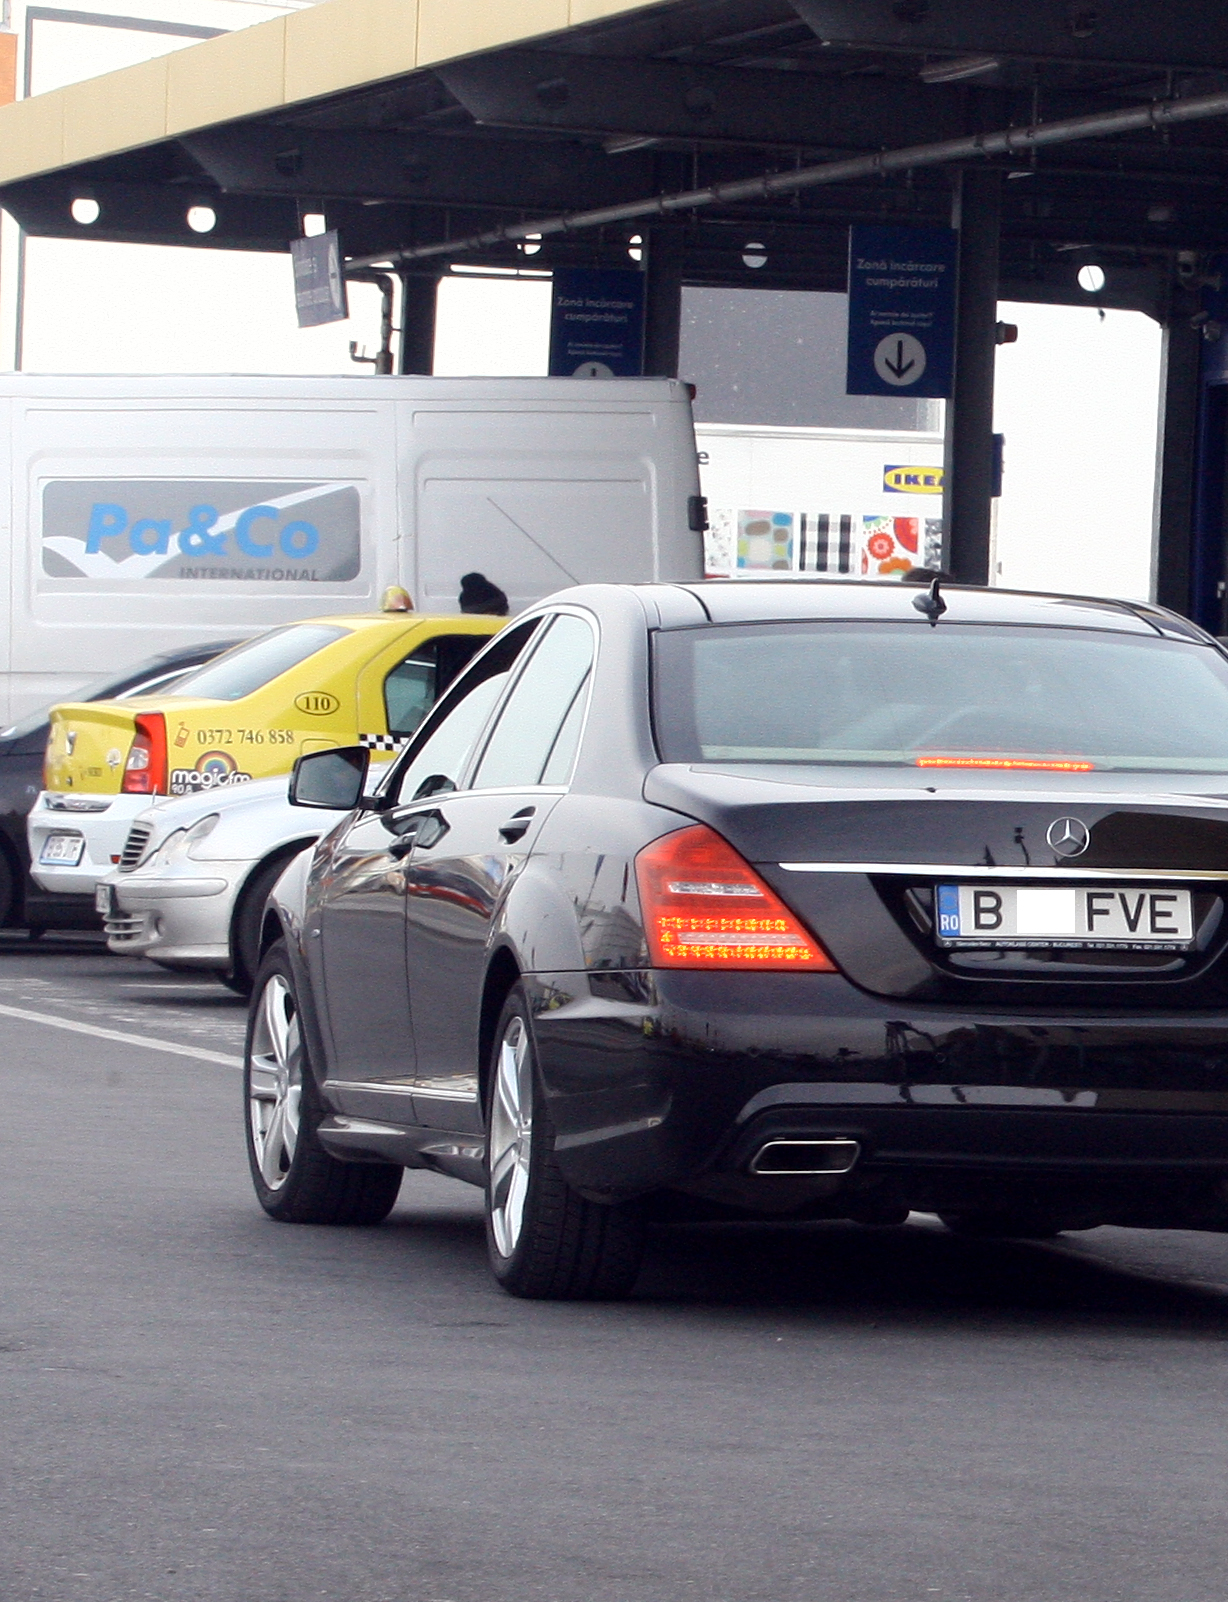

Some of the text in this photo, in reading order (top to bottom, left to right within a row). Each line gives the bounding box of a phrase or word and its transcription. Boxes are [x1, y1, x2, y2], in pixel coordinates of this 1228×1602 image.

[84, 503, 320, 559] Pa&Co
[179, 567, 319, 581] INTERNATIONAL
[303, 696, 330, 711] 110
[197, 729, 294, 745] 0372 746 858
[940, 890, 1179, 934] RO B FVE
